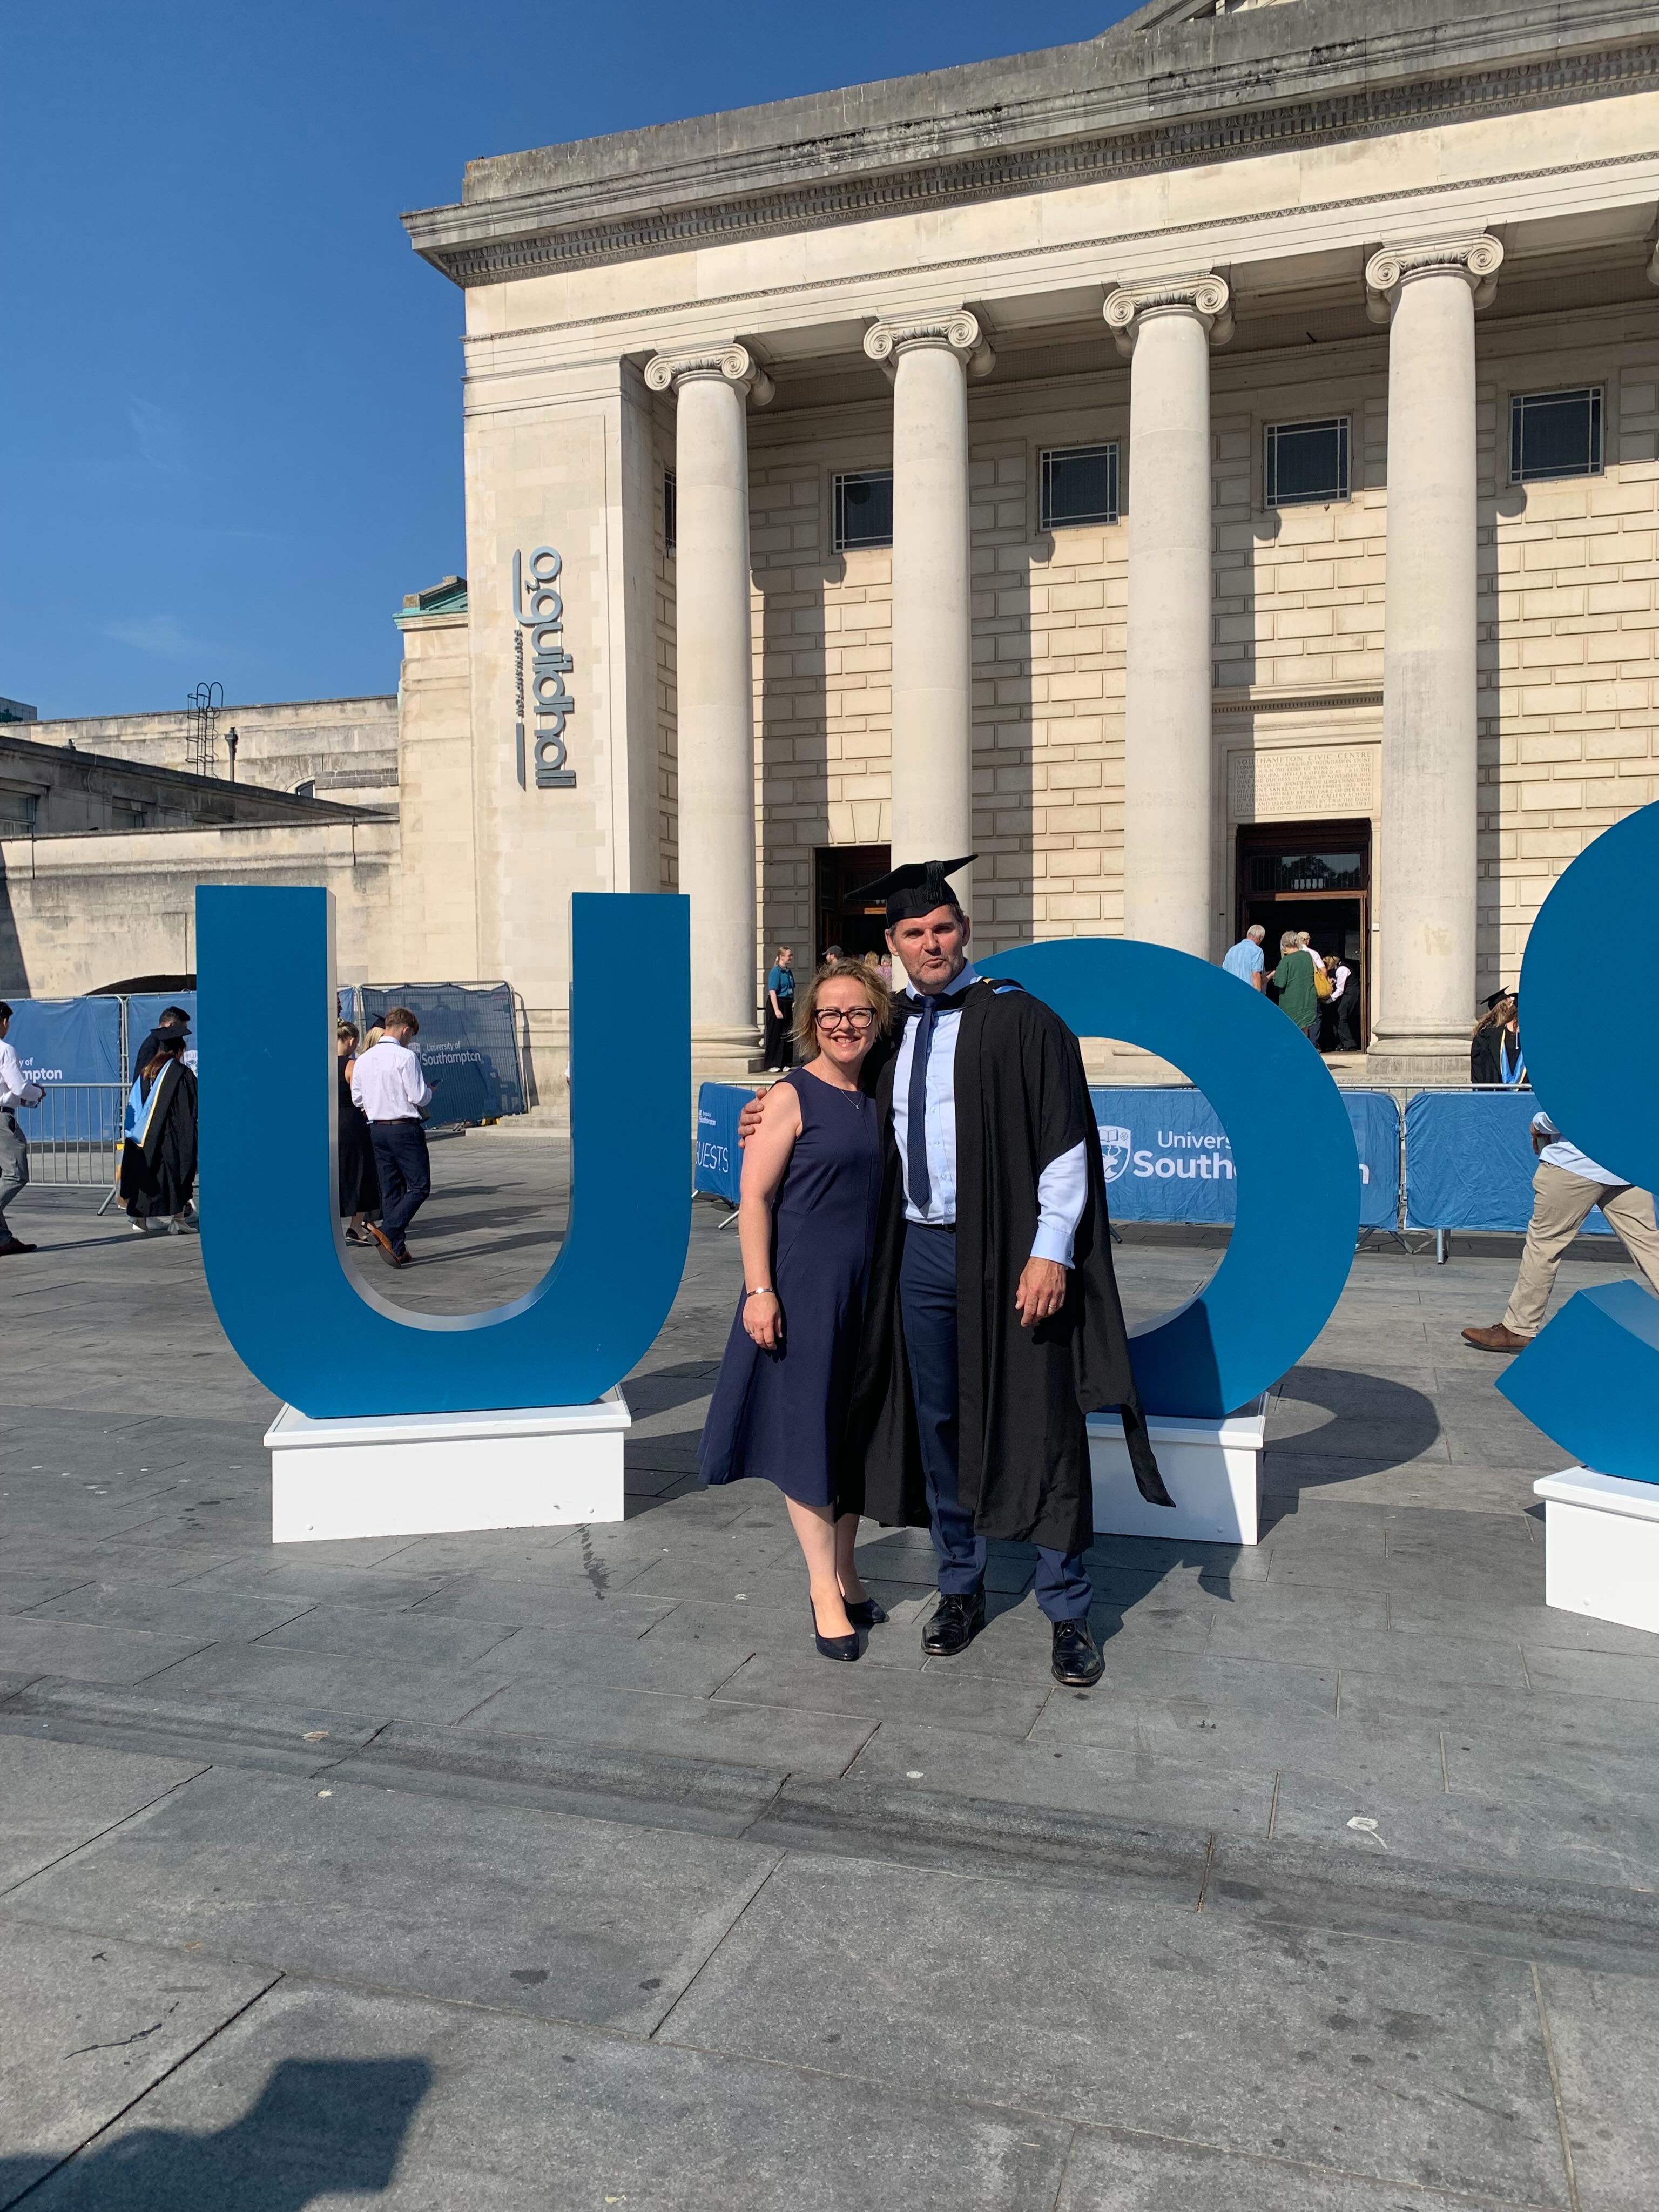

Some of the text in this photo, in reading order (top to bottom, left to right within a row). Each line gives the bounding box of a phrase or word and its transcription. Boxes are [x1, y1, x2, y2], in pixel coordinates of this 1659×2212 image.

[1237, 756, 1302, 765] SOUTHAMPTON
[427, 1041, 461, 1051] University of
[25, 1057, 33, 1066] of
[422, 1050, 481, 1066] Southampton
[1158, 1131, 1231, 1149] Univers
